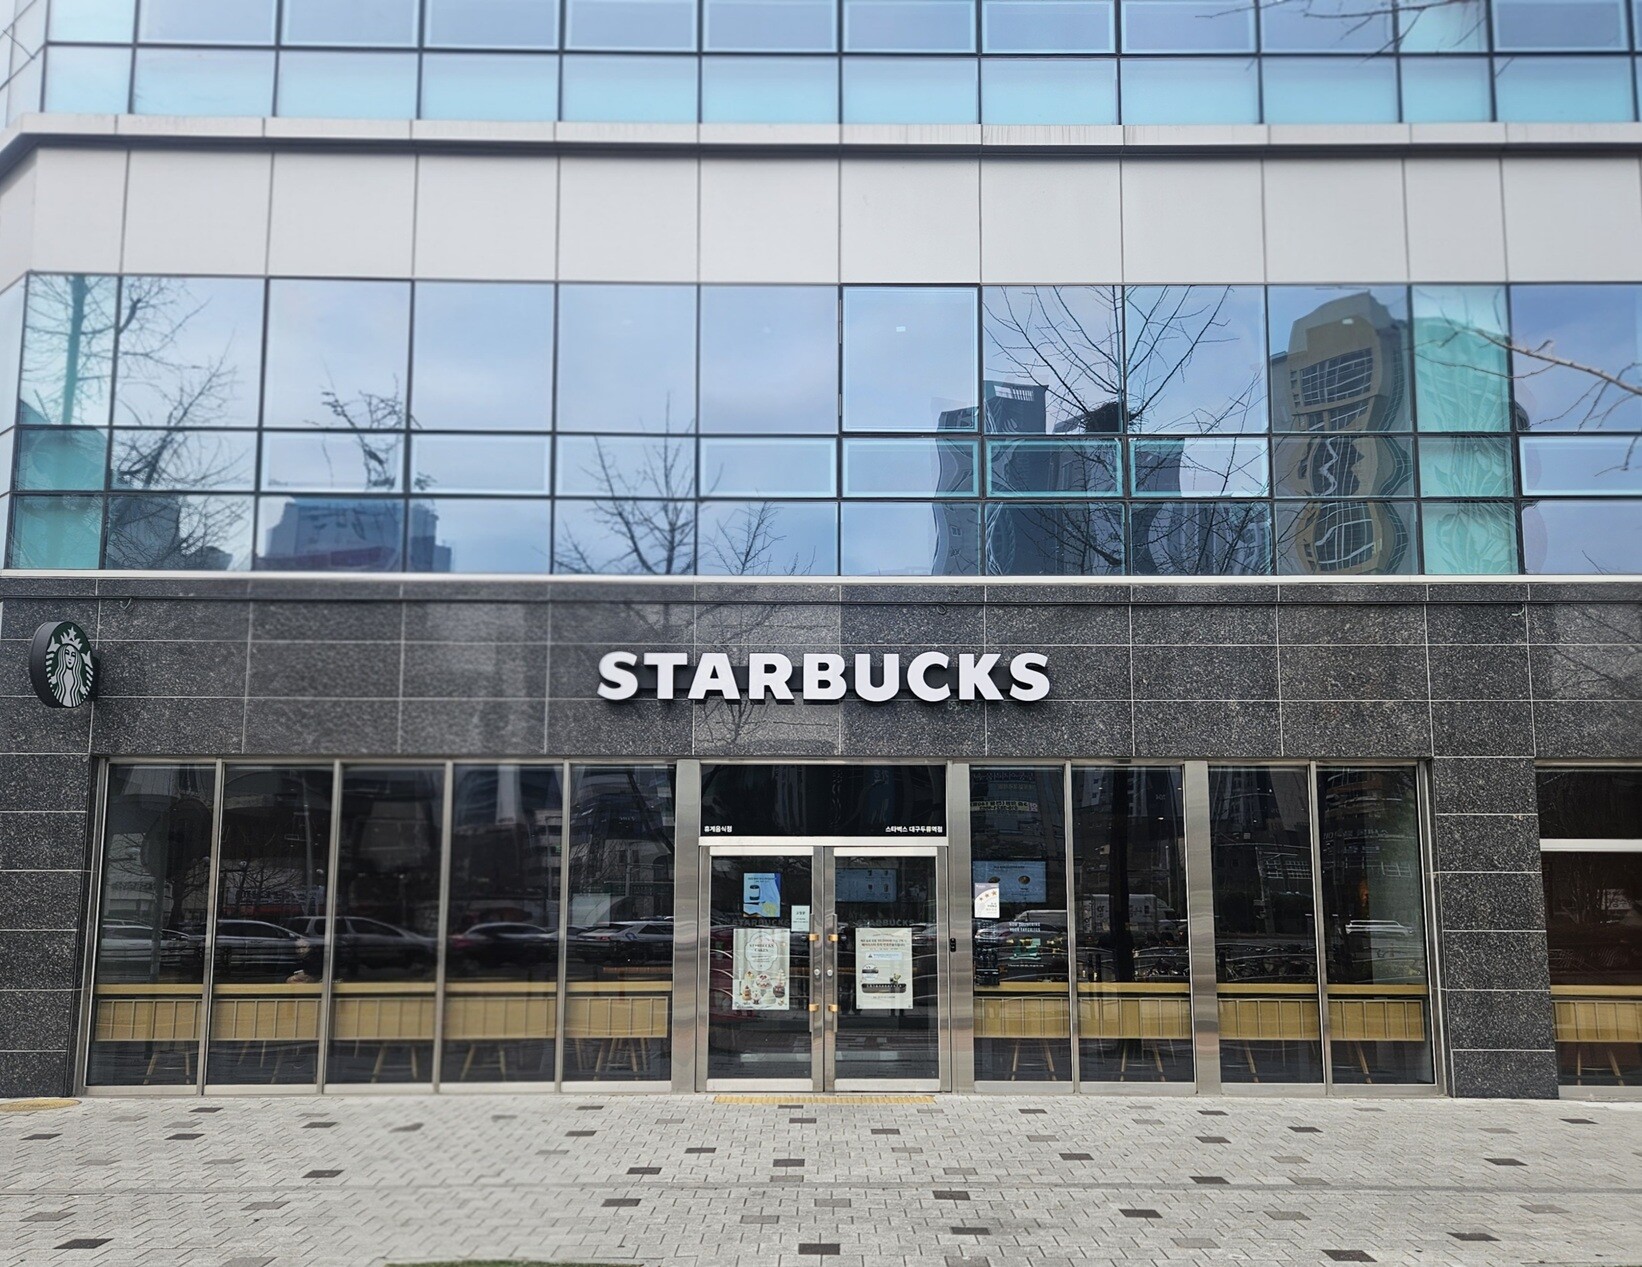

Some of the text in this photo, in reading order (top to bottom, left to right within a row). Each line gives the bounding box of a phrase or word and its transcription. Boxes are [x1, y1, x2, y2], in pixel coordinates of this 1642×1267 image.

[597, 651, 1050, 702] STARBUCKS
[704, 825, 733, 833] 휴게음식점
[885, 825, 908, 833] 스타벅스
[732, 918, 790, 927] STARBUCKS
[857, 918, 915, 927] STARBUCKS
